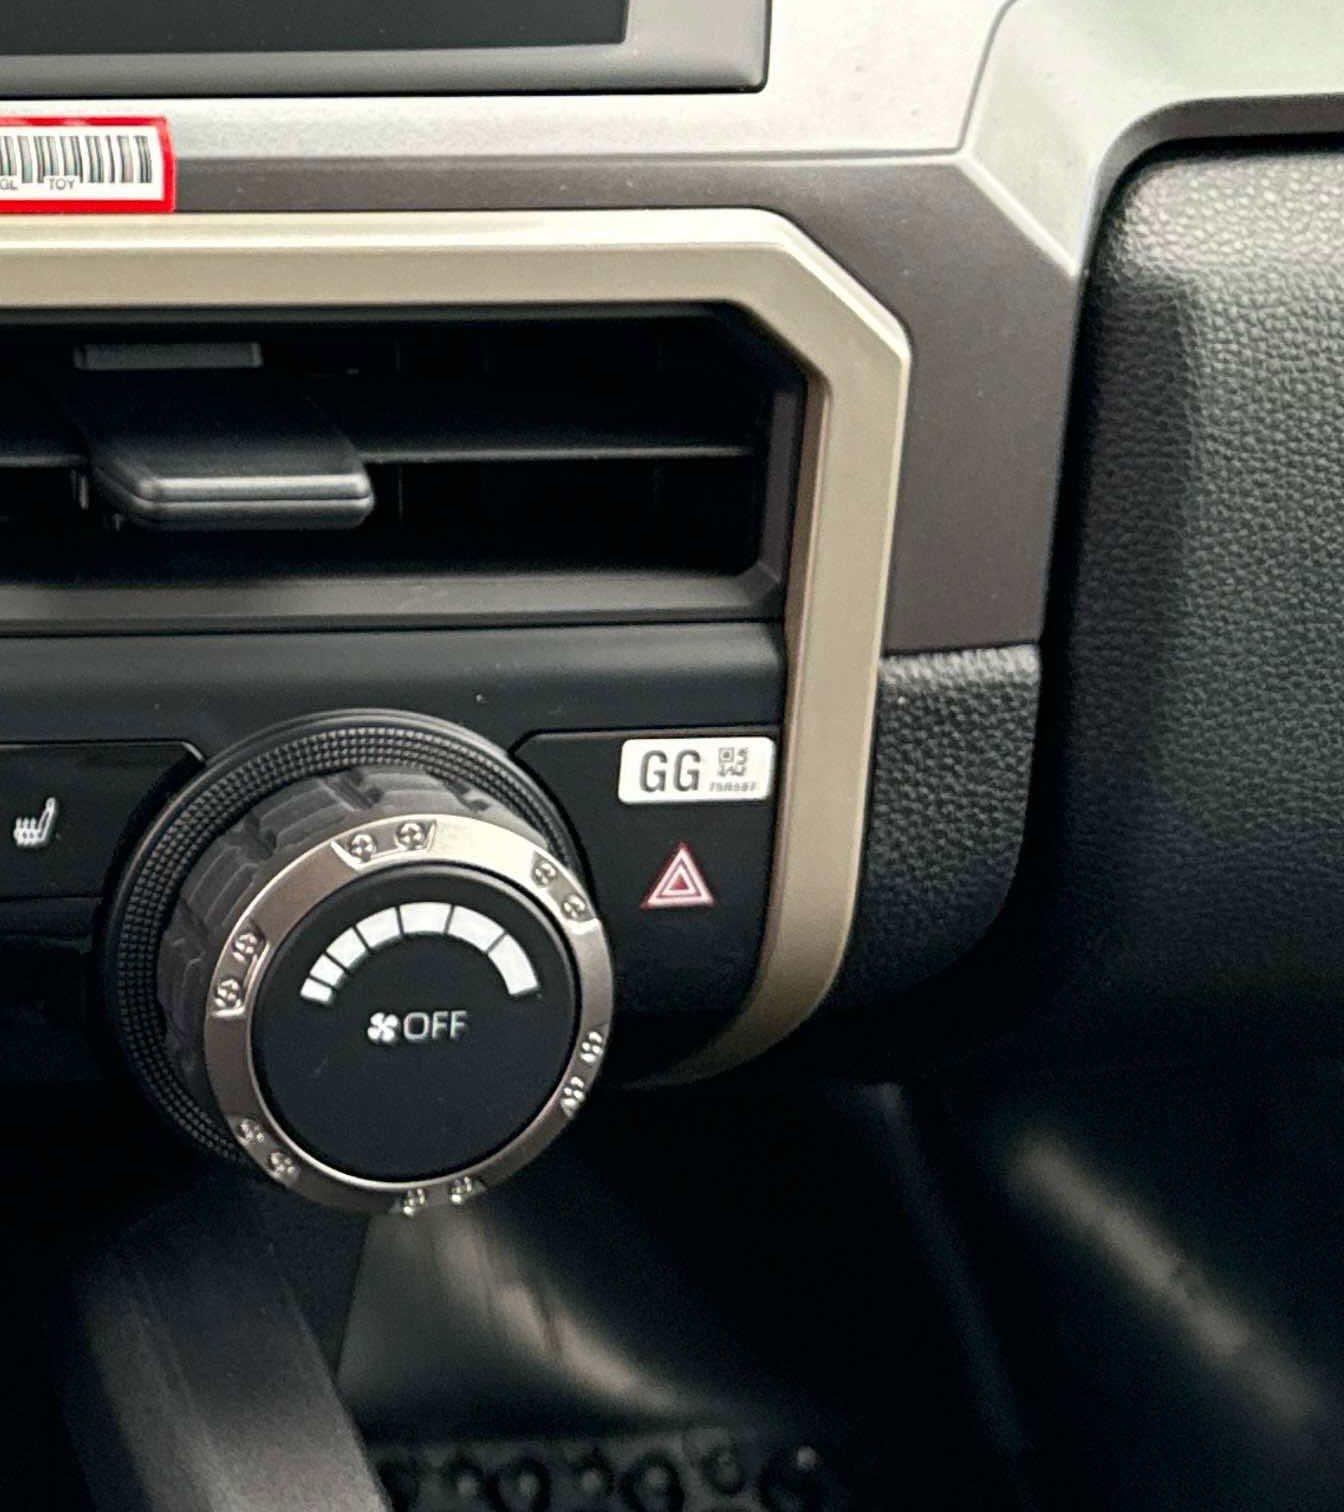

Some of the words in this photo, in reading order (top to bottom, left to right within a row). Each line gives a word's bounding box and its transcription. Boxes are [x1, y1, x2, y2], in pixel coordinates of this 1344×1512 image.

[48, 178, 75, 191] TOY
[639, 749, 702, 793] GG
[403, 1010, 467, 1040] OFF
